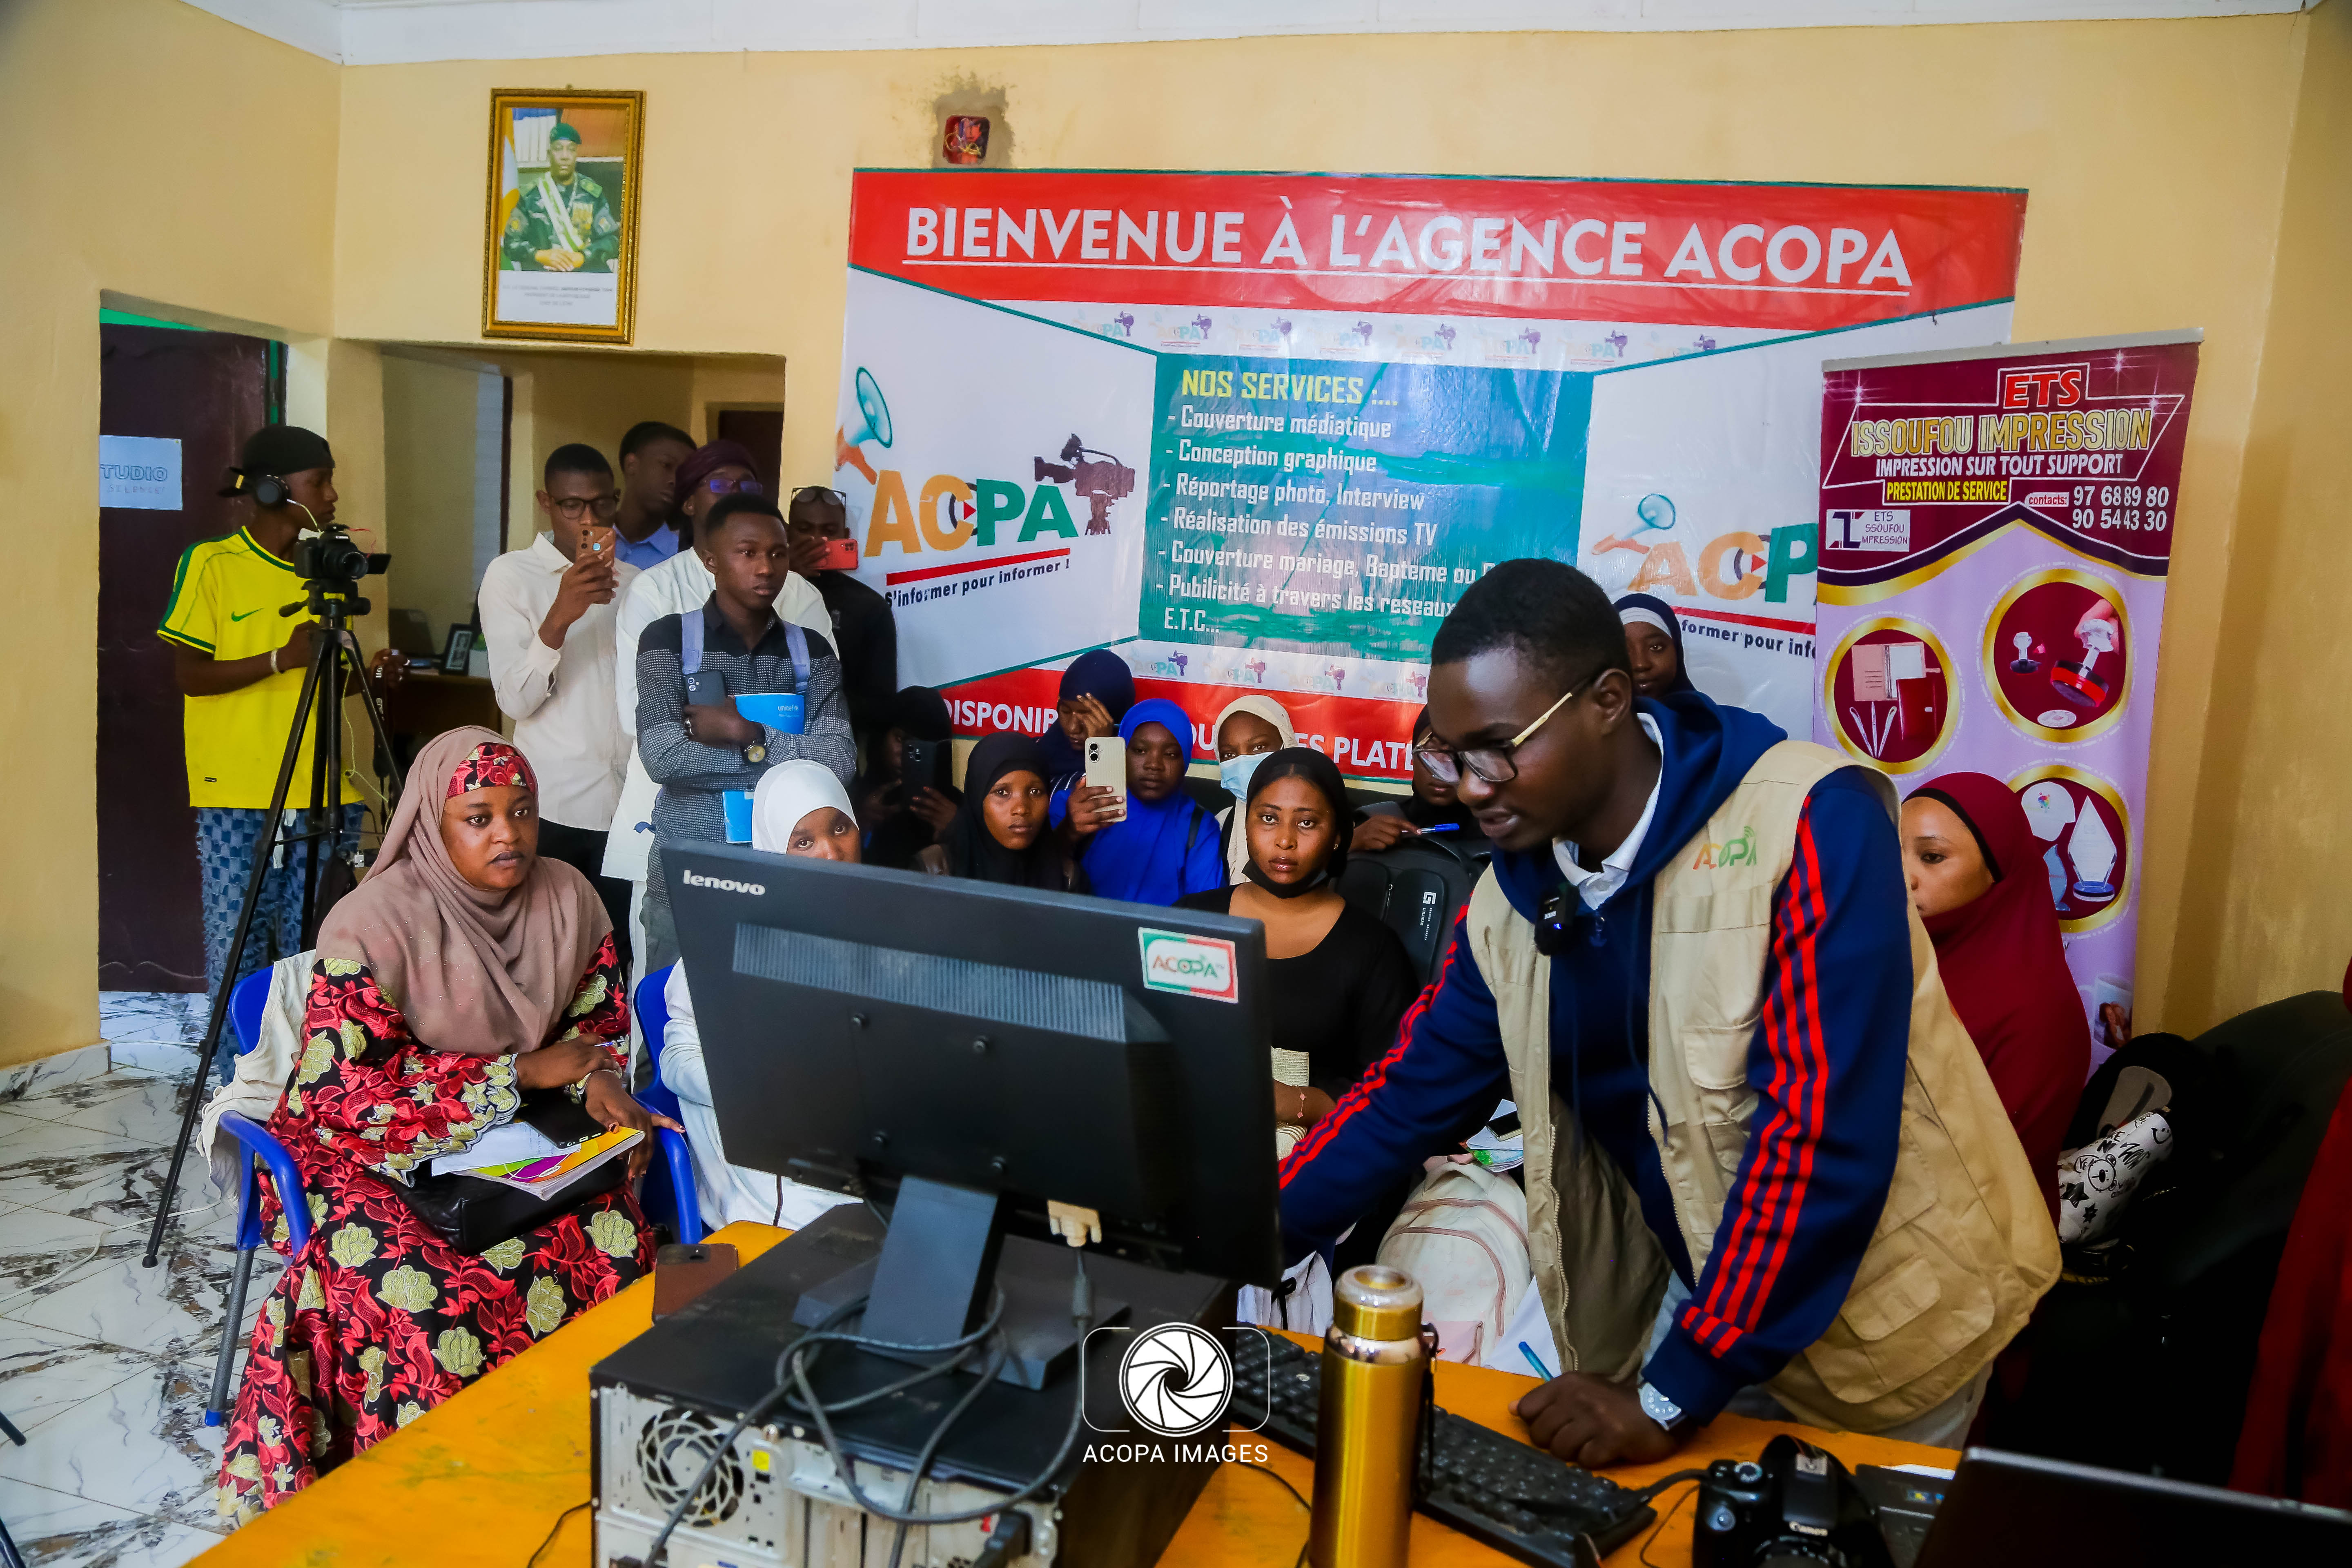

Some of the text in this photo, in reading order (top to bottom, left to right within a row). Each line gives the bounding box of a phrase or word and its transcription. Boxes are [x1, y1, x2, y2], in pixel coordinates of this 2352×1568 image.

[906, 196, 1913, 287] BIENVENUE À L'AGENCE ACOPA
[1182, 369, 1233, 399] NOS
[1241, 372, 1364, 404] SERVICES
[2003, 370, 2081, 409] ETS
[1181, 404, 1284, 432] Couverture
[1290, 412, 1391, 442] médiatique
[1851, 408, 2153, 457] ISSOUFOU IMPRESSION
[100, 464, 168, 482] TUDIO
[1178, 438, 1278, 469] Conception
[1283, 446, 1377, 476] graphique
[1876, 453, 2123, 477] IMPRESSION SUR TOUT SUPPORT
[1176, 472, 1269, 505] Réportage
[1274, 479, 1330, 507] photo,
[1336, 482, 1425, 510] Interview
[1886, 480, 2007, 501] PRESTATION DE SERVICE
[2028, 494, 2067, 505] contacts:
[2073, 485, 2095, 506] 97
[2145, 486, 2169, 508] 80
[1173, 506, 1272, 536] Réalisation
[1277, 513, 1309, 537] des
[1314, 519, 1408, 545] émissions
[1414, 522, 1439, 546] TV
[1874, 511, 1894, 522] ETS
[2072, 508, 2094, 529] 90
[2144, 510, 2167, 532] 30
[962, 575, 995, 597] pour
[999, 562, 1060, 585] informer
[1171, 539, 1274, 569] Couverture
[1279, 552, 1359, 580] mariage,
[1365, 553, 1448, 584] Bapteme
[1453, 567, 1476, 584] ou
[1169, 573, 1251, 602] Pubilicité
[1256, 584, 1266, 603] à
[1272, 585, 1342, 610] travers
[1347, 586, 1374, 612] les
[1380, 597, 1455, 617] reseaux
[1681, 619, 1739, 642] former
[1744, 633, 1784, 652] pour
[943, 698, 1414, 771] ISPONIB ES PLATE
[683, 869, 766, 896] lenovo
